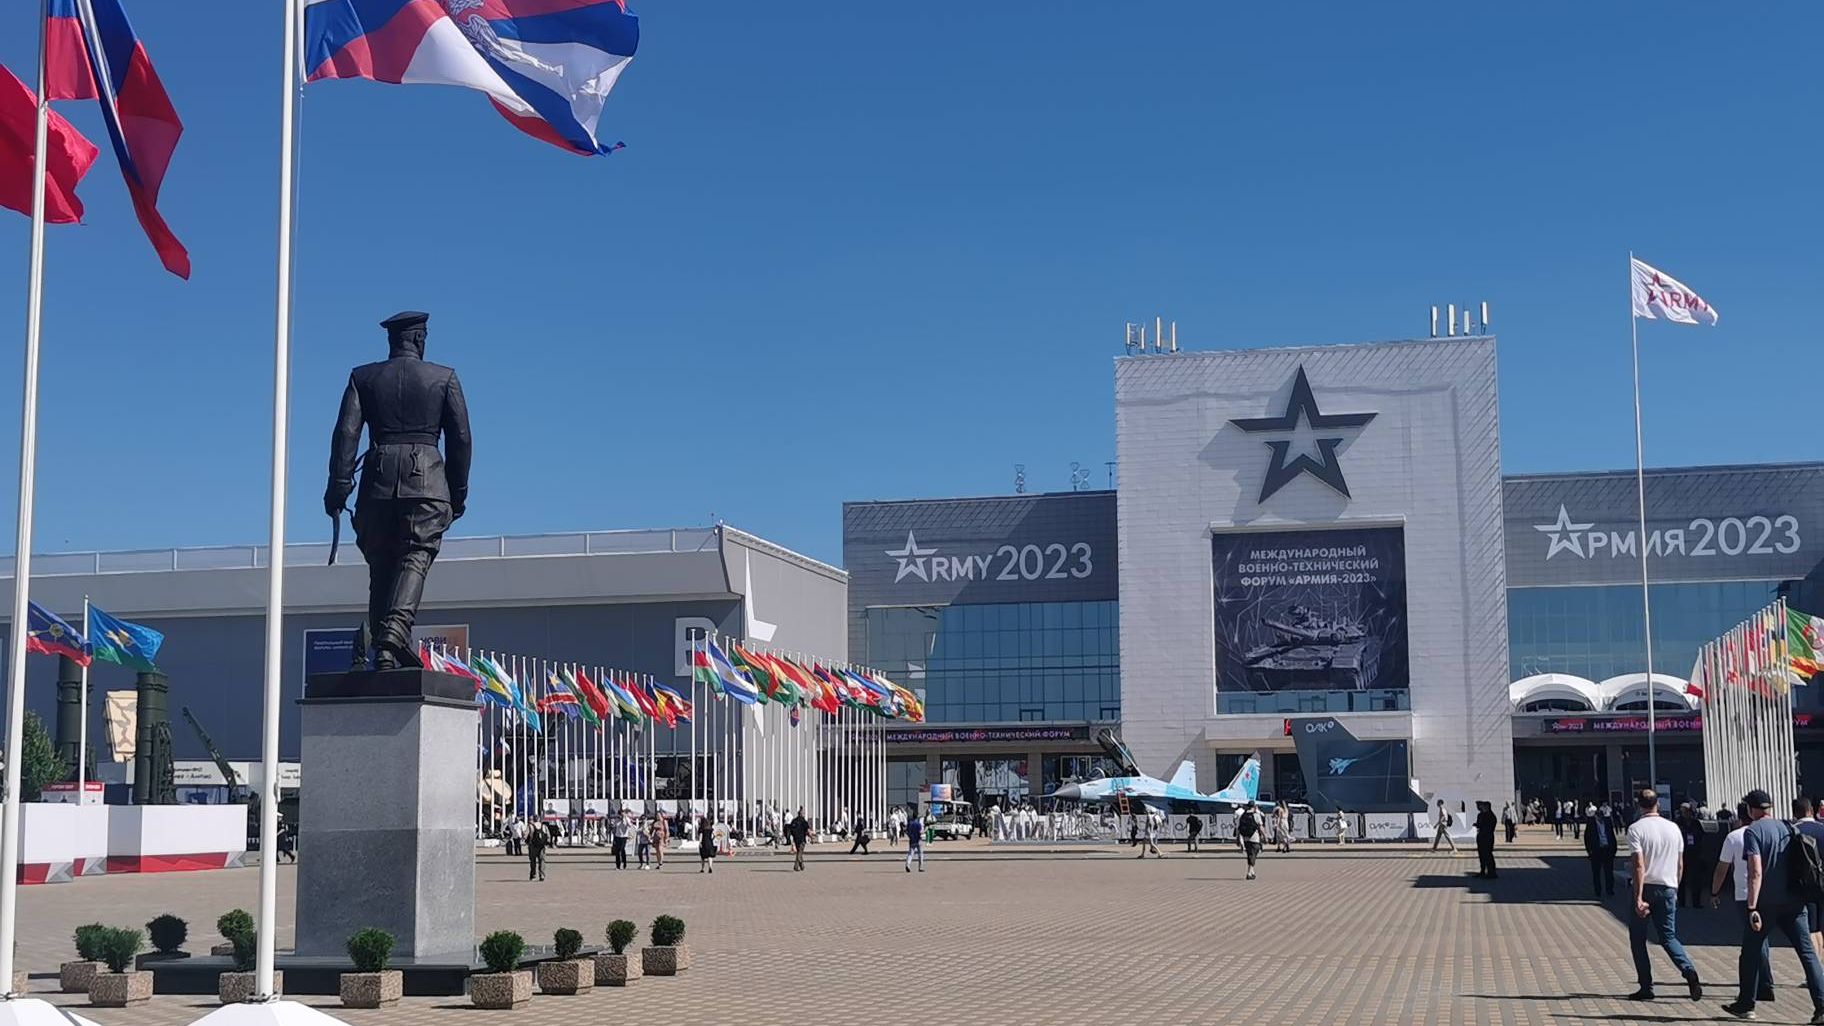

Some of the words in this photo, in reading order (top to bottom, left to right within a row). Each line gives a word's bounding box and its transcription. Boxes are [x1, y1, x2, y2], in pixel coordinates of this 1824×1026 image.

[1688, 514, 1801, 556] 2023
[1250, 544, 1366, 560] МЕЖДУНАРОДНЫЙ
[995, 542, 1093, 581] 2023
[1238, 557, 1379, 574] ВОЕННО-ТЕХНИЧЕСКИЙ
[1240, 575, 1286, 587] ФОРУМ
[1288, 572, 1377, 586] «АРМИЯ-2023»
[1592, 719, 1671, 730] МЕЖДУНАРОНЫЙ
